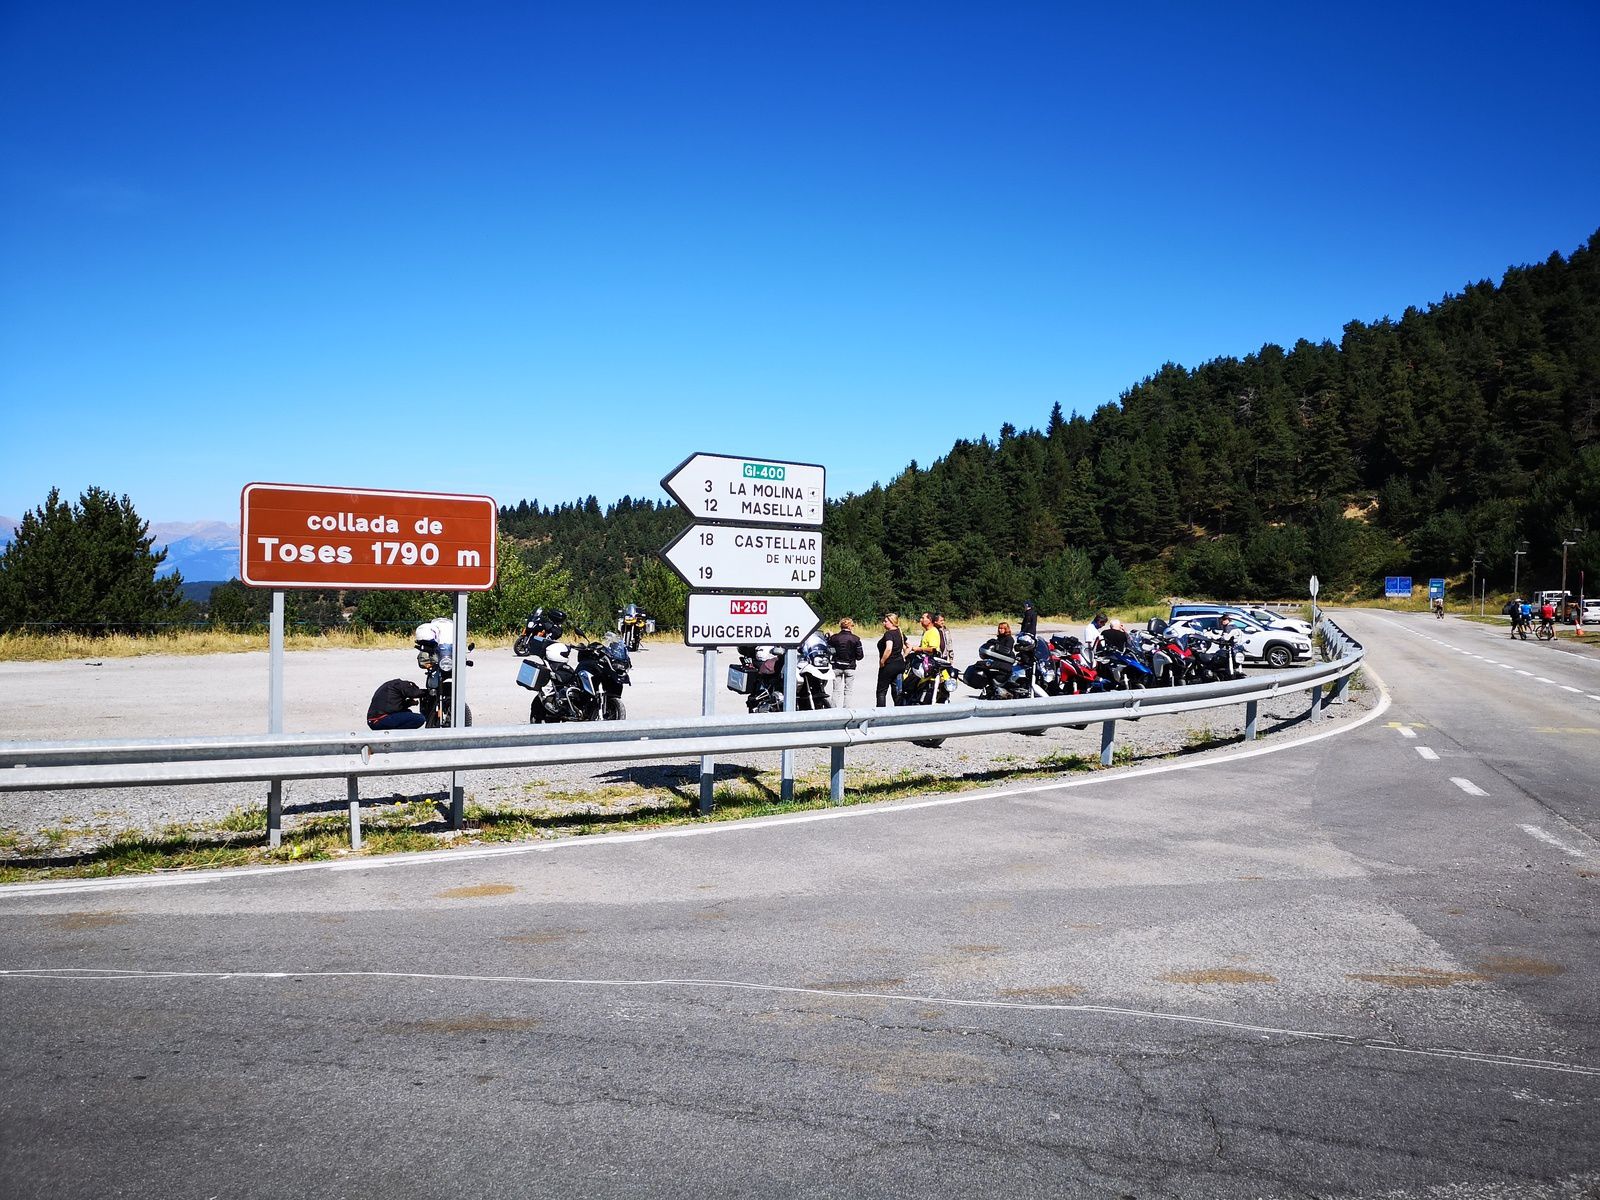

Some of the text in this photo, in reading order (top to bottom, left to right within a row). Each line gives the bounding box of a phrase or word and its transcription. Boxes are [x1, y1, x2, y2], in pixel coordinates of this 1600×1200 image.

[704, 480, 803, 500] 3 LA MOLINA
[704, 498, 803, 517] 12 MASELLA
[307, 512, 443, 535] collada de
[699, 533, 816, 550] 18 CASTELLAR
[257, 537, 480, 567] Toses 1790 m
[766, 554, 779, 564] DE
[698, 566, 816, 582] 19 ALP
[731, 601, 766, 613] N-260
[692, 622, 800, 638] PUIGCERDÀ 26
